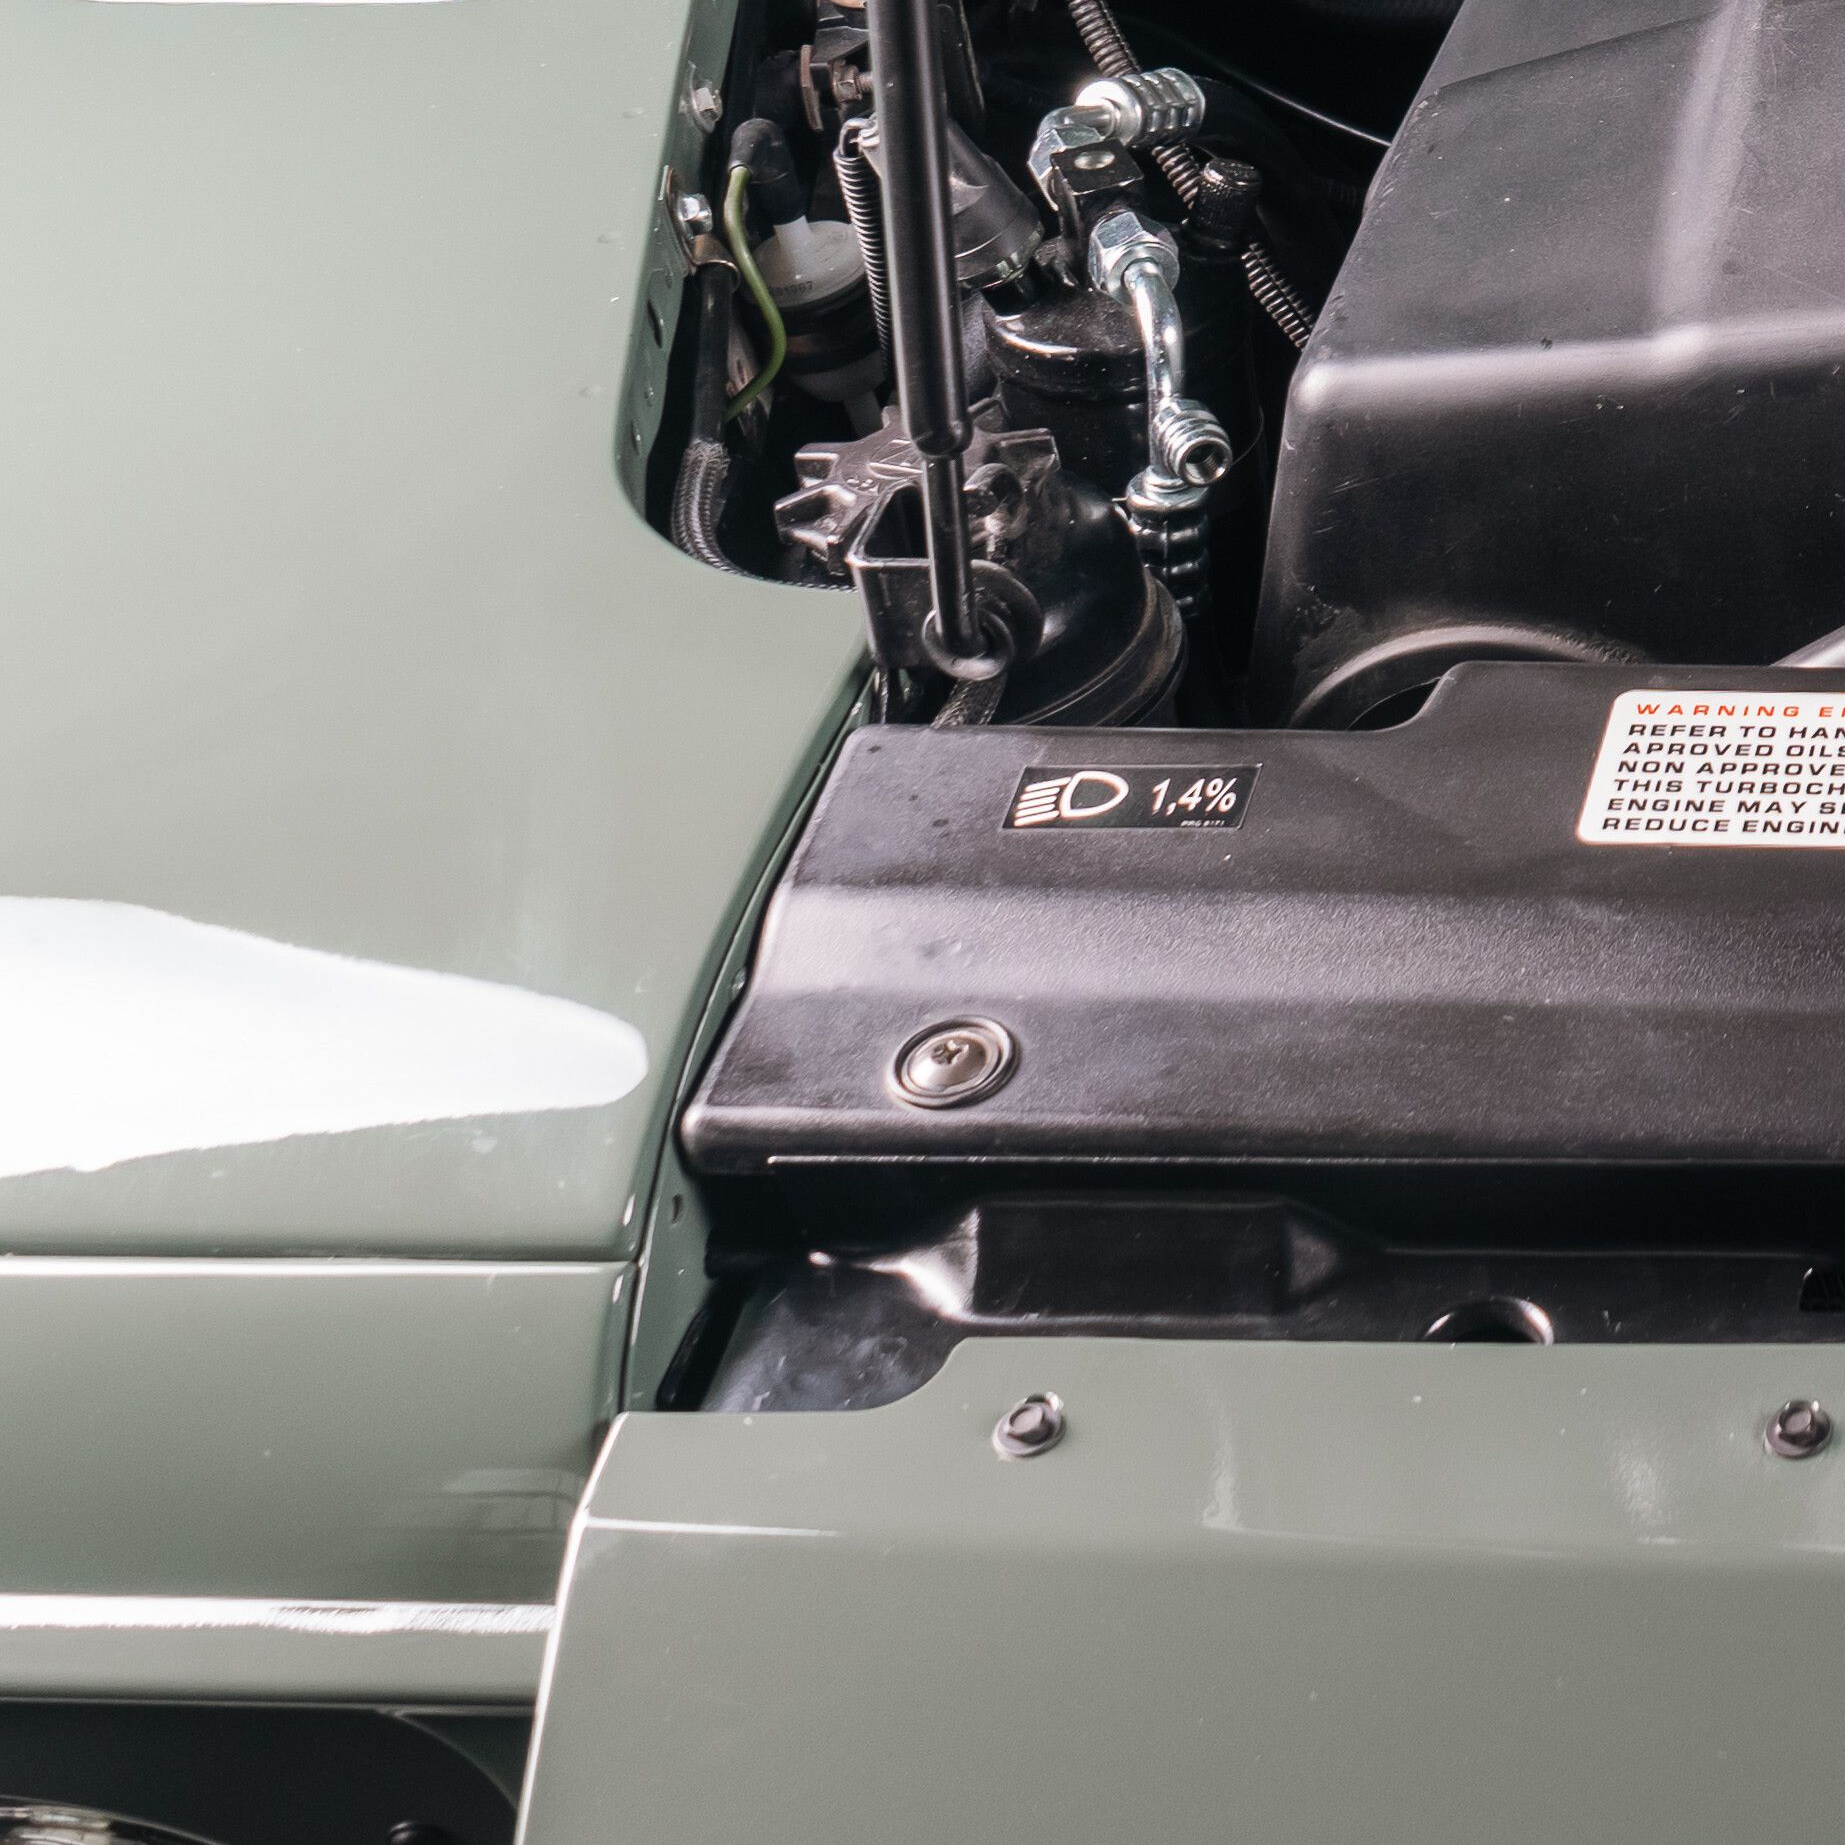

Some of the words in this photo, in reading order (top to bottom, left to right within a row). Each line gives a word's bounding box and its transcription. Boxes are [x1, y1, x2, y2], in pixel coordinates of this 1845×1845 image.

[1636, 703, 1801, 717] WARNING
[1627, 723, 1728, 738] REFER
[1739, 725, 1777, 739] TO
[1622, 742, 1774, 757] APROVED
[1617, 760, 1686, 774] NON
[1613, 779, 1684, 793] THIS
[1151, 776, 1238, 817] 1,4%
[1607, 798, 1727, 813] ENGINE
[1736, 800, 1808, 814] MAY
[1602, 817, 1731, 832] REDUCE
